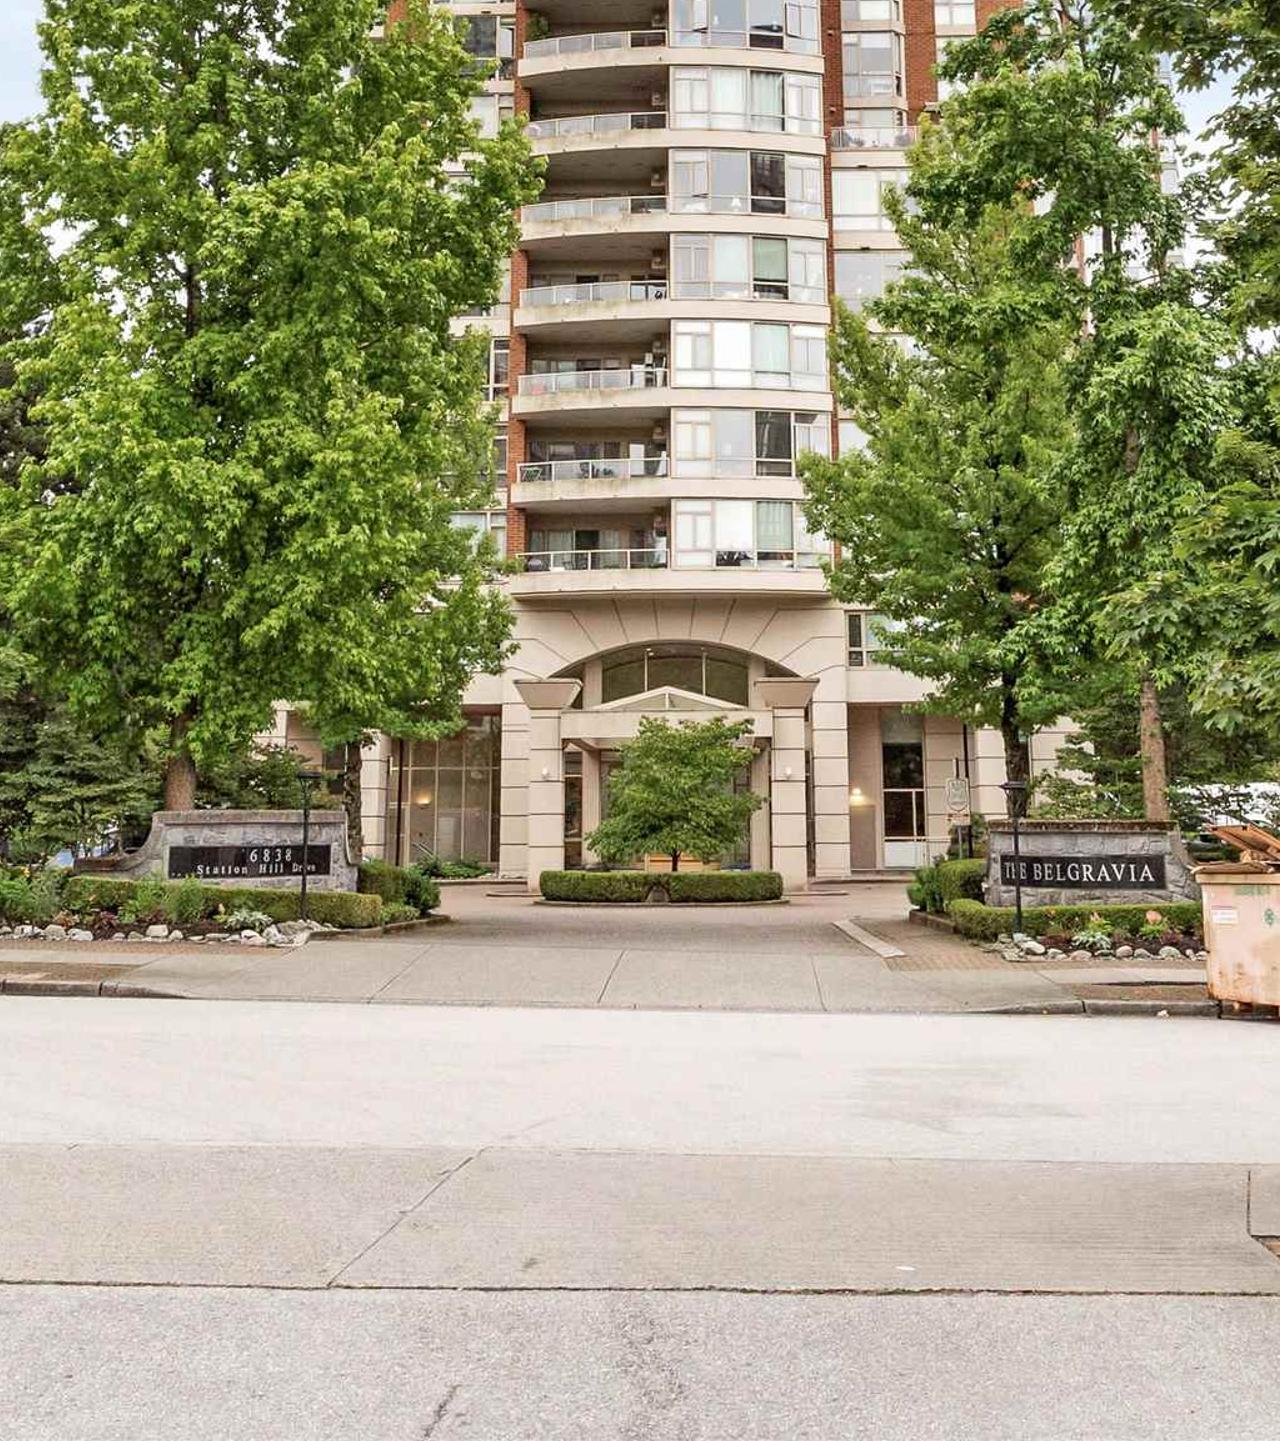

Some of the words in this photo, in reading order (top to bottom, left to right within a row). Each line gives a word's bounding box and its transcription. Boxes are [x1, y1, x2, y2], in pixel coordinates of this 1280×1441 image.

[249, 848, 292, 863] 6838
[196, 865, 249, 876] Station
[258, 863, 284, 873] Hill
[292, 863, 316, 872] Drve
[1033, 863, 1155, 882] BELGRAVIA
